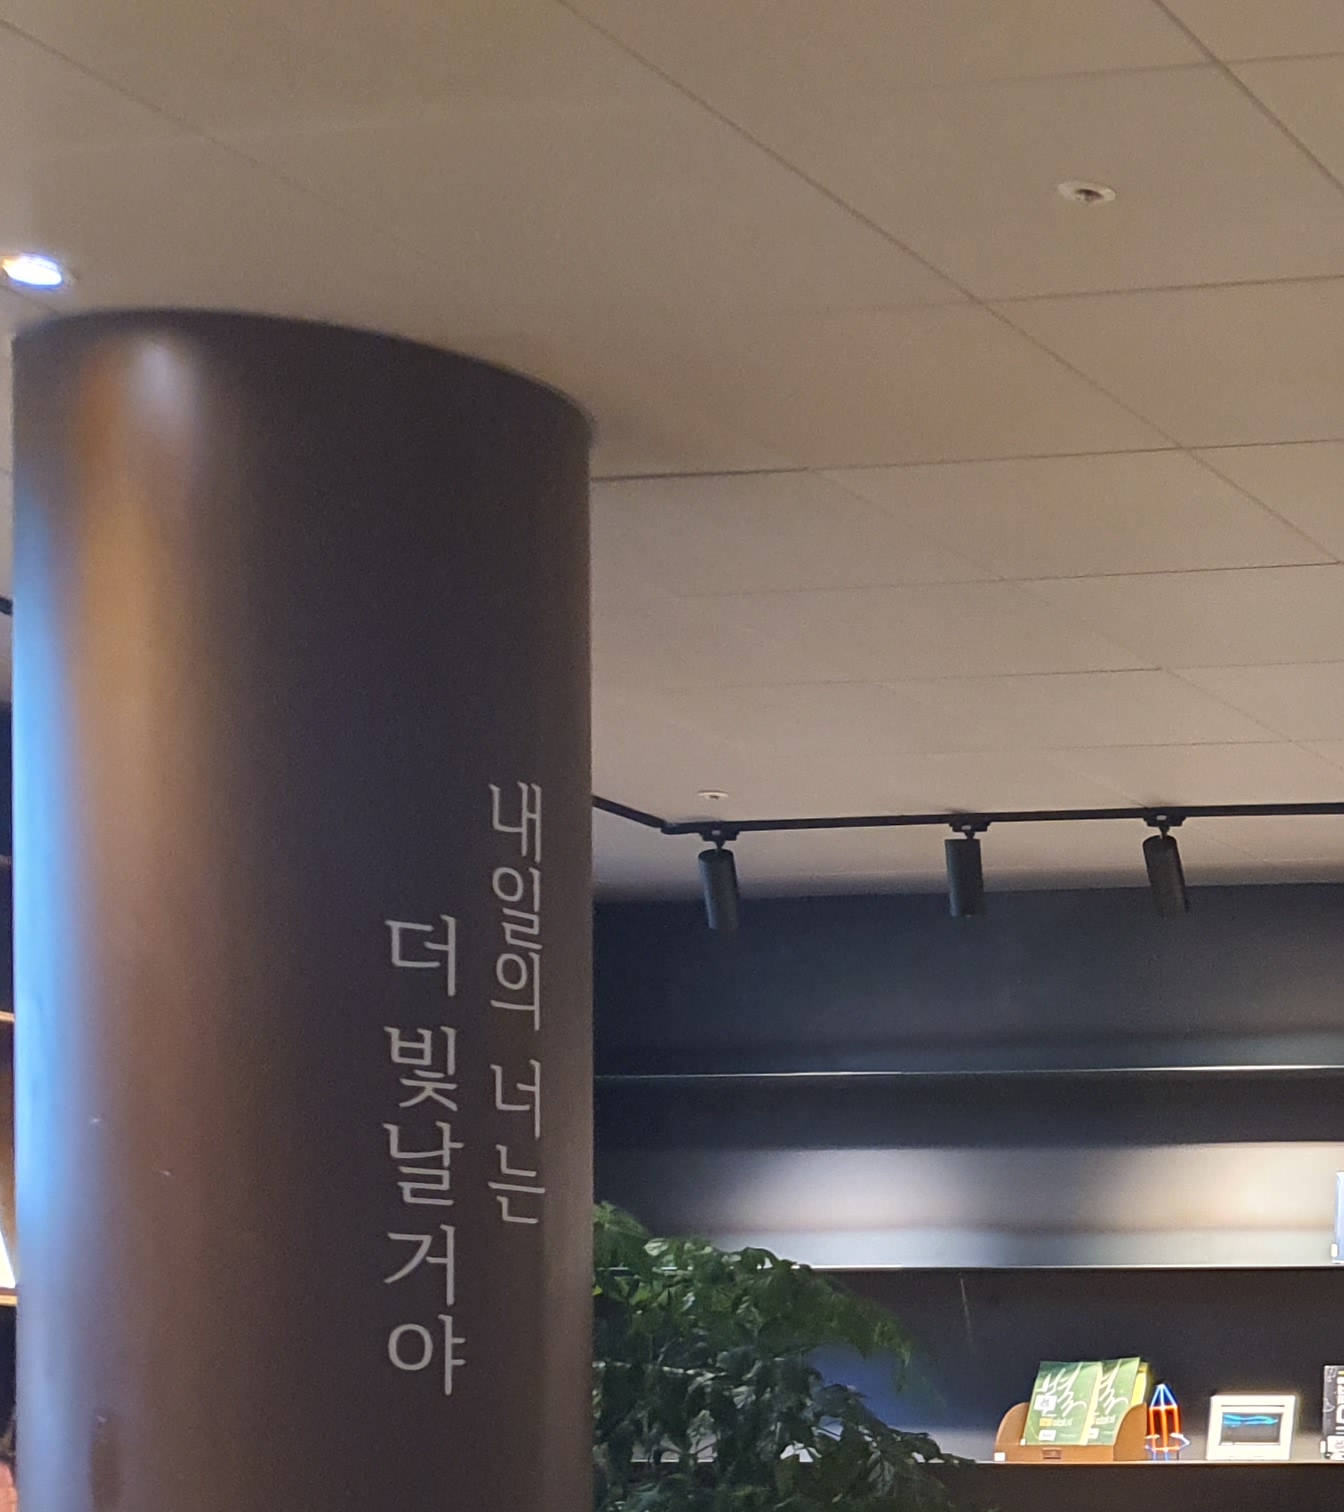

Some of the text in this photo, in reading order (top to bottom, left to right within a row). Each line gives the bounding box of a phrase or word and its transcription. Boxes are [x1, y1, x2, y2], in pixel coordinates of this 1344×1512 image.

[383, 913, 458, 998] 더
[486, 780, 546, 1226] 내일의 너는
